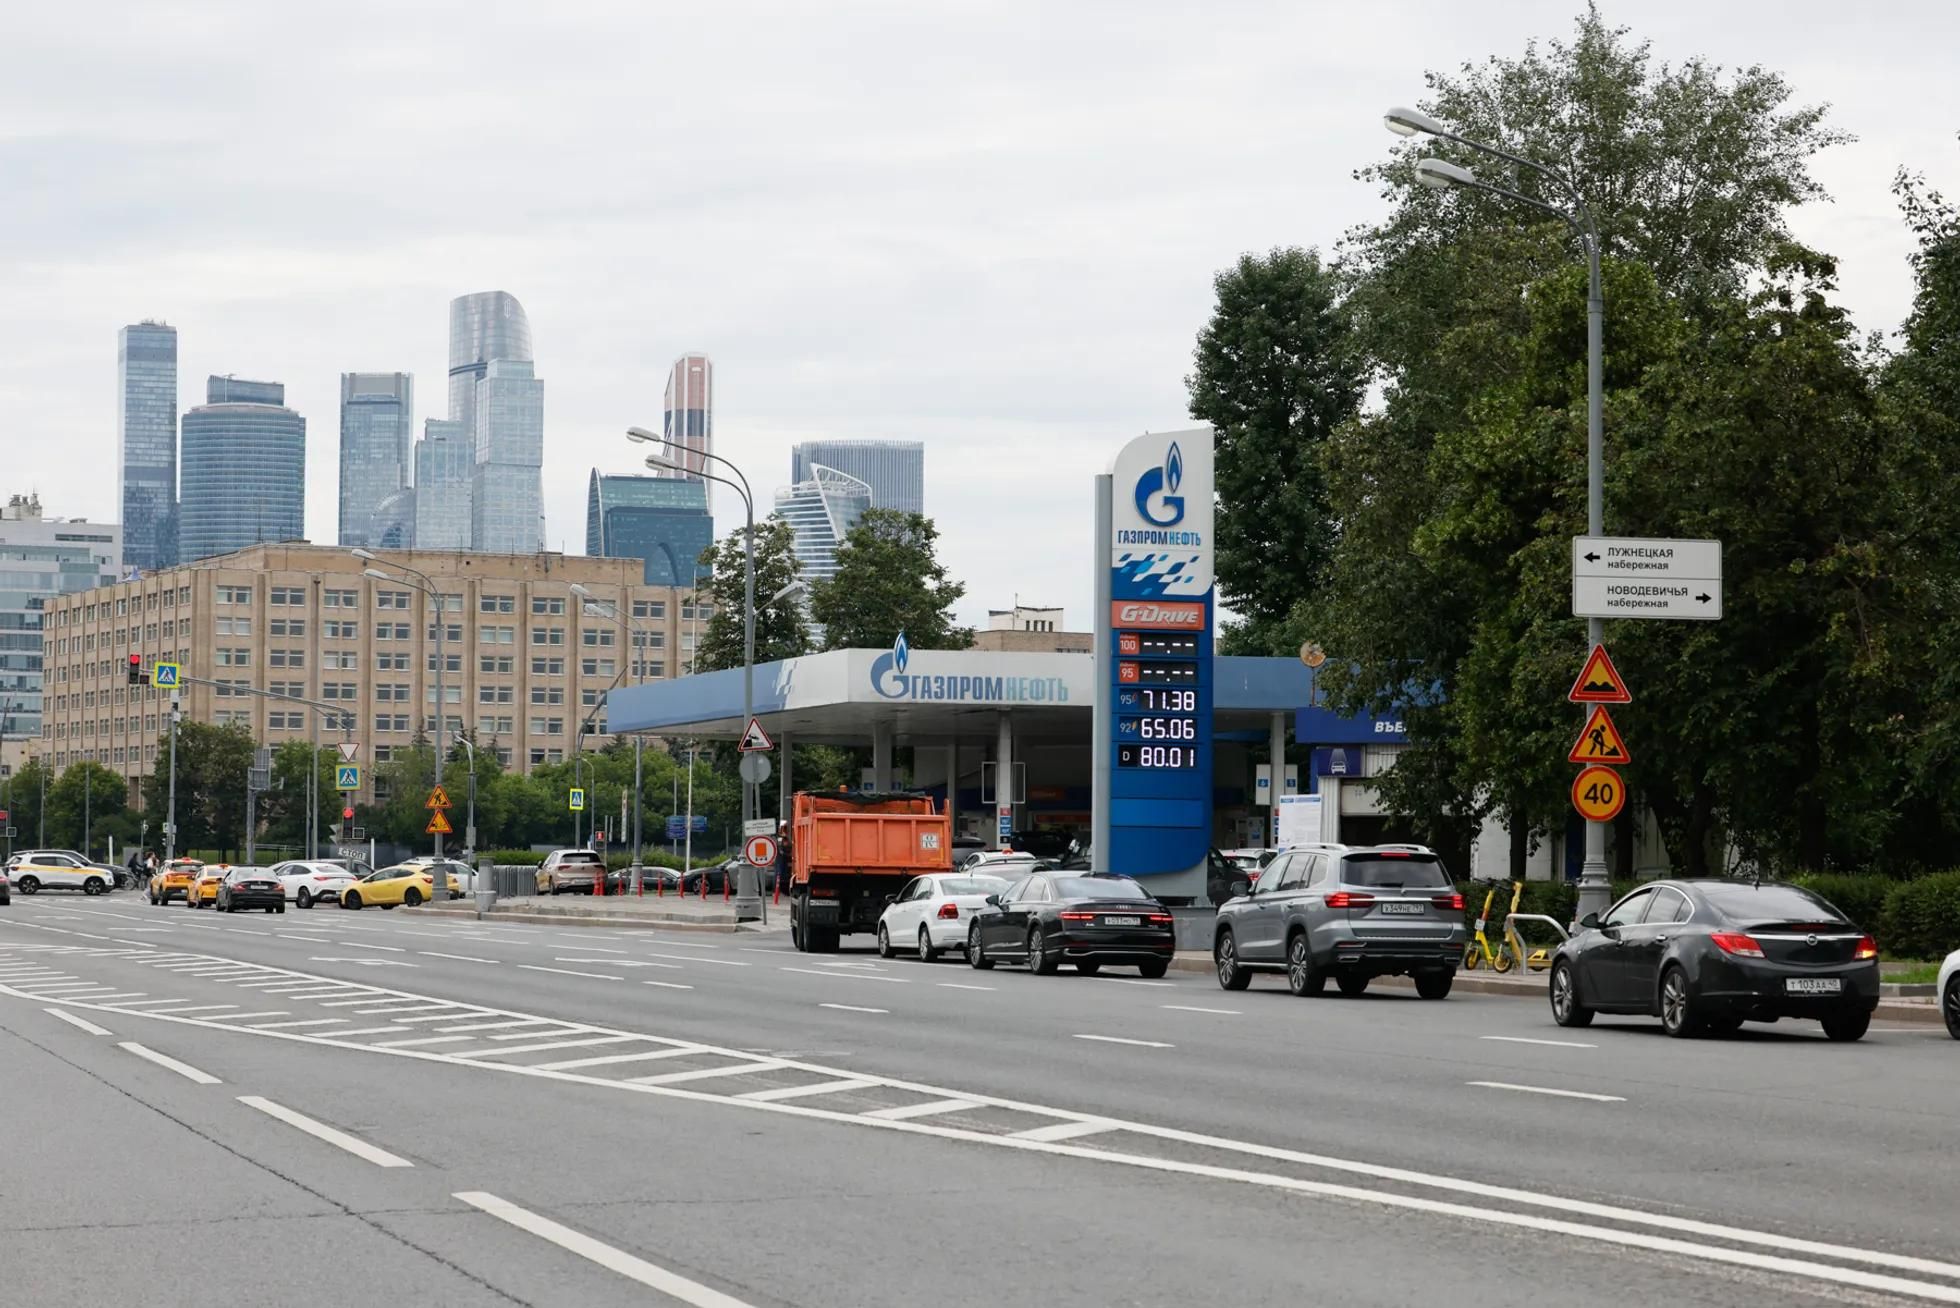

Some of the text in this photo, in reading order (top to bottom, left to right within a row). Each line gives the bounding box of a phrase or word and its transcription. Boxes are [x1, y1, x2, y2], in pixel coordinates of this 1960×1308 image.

[1607, 547, 1673, 558] ЛУЖНЕЦКАЯ
[1607, 560, 1669, 571] набережная
[1607, 585, 1688, 596] НОВОДЕВИЧЬЯ
[1607, 597, 1669, 609] набережная
[1120, 640, 1136, 650] 100
[1121, 668, 1134, 678] 95
[1120, 690, 1195, 711] 95 71.38
[1120, 718, 1194, 739] 92 65.06
[1374, 721, 1407, 733] ВЪЕ
[1122, 747, 1194, 768] D 80.01
[1584, 783, 1613, 804] 40
